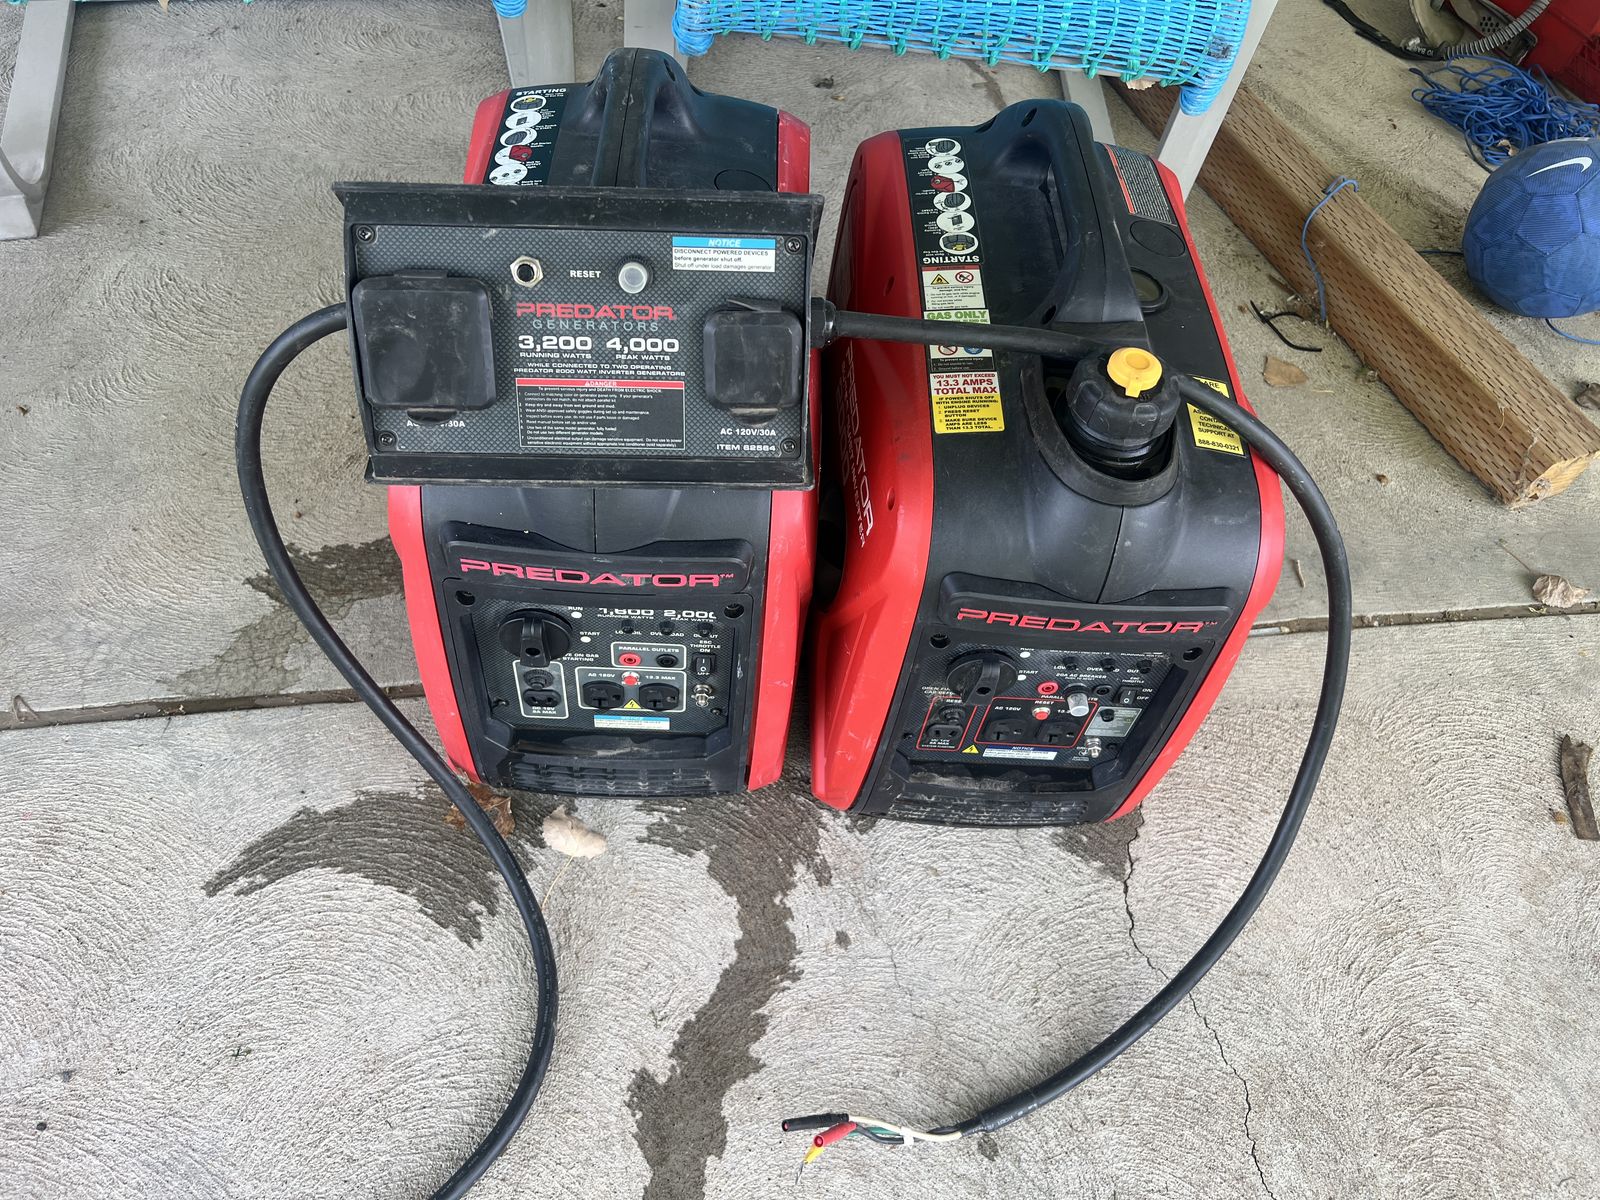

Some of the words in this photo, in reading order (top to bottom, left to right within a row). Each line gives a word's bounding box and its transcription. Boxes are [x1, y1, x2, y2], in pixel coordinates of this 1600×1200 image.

[708, 239, 741, 247] NOTICE
[923, 256, 979, 264] STARTING
[570, 270, 602, 278] RESET
[516, 302, 674, 320] PREDATOR
[927, 312, 952, 320] GAS
[954, 311, 987, 319] ONLY
[532, 320, 658, 332] GENERATORS
[518, 335, 593, 351] 3,200
[606, 338, 679, 353] 4,000
[1198, 428, 1226, 436] SUPPORT
